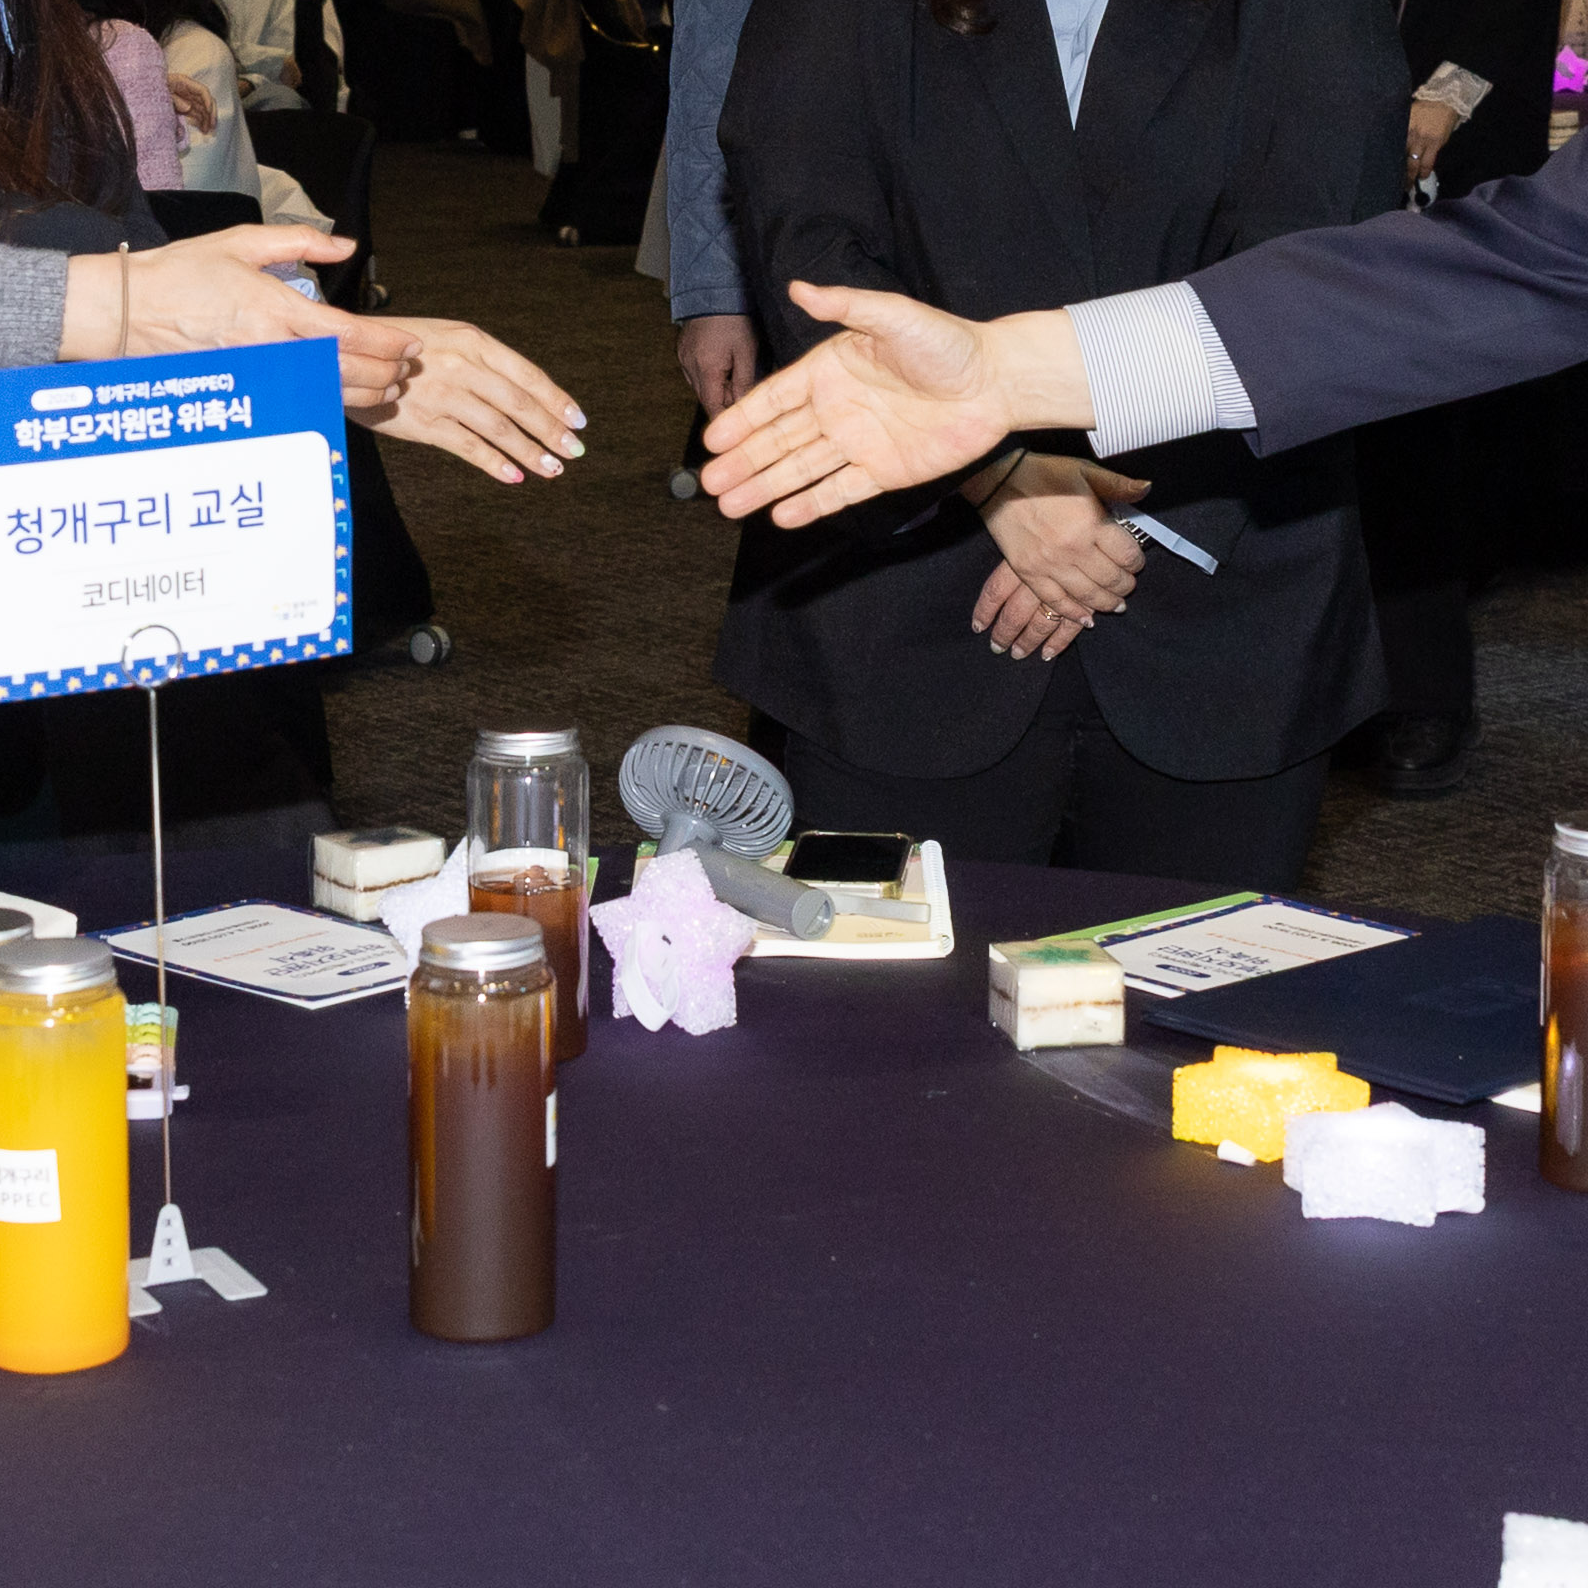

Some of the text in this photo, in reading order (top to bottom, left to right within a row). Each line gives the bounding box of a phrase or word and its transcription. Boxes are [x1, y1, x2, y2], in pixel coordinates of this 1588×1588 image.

[95, 380, 151, 405] 청개구리
[14, 395, 253, 452] 학부모지원단 위촉식
[7, 481, 265, 555] 청개구리 교실
[80, 568, 207, 609] 코디네이터
